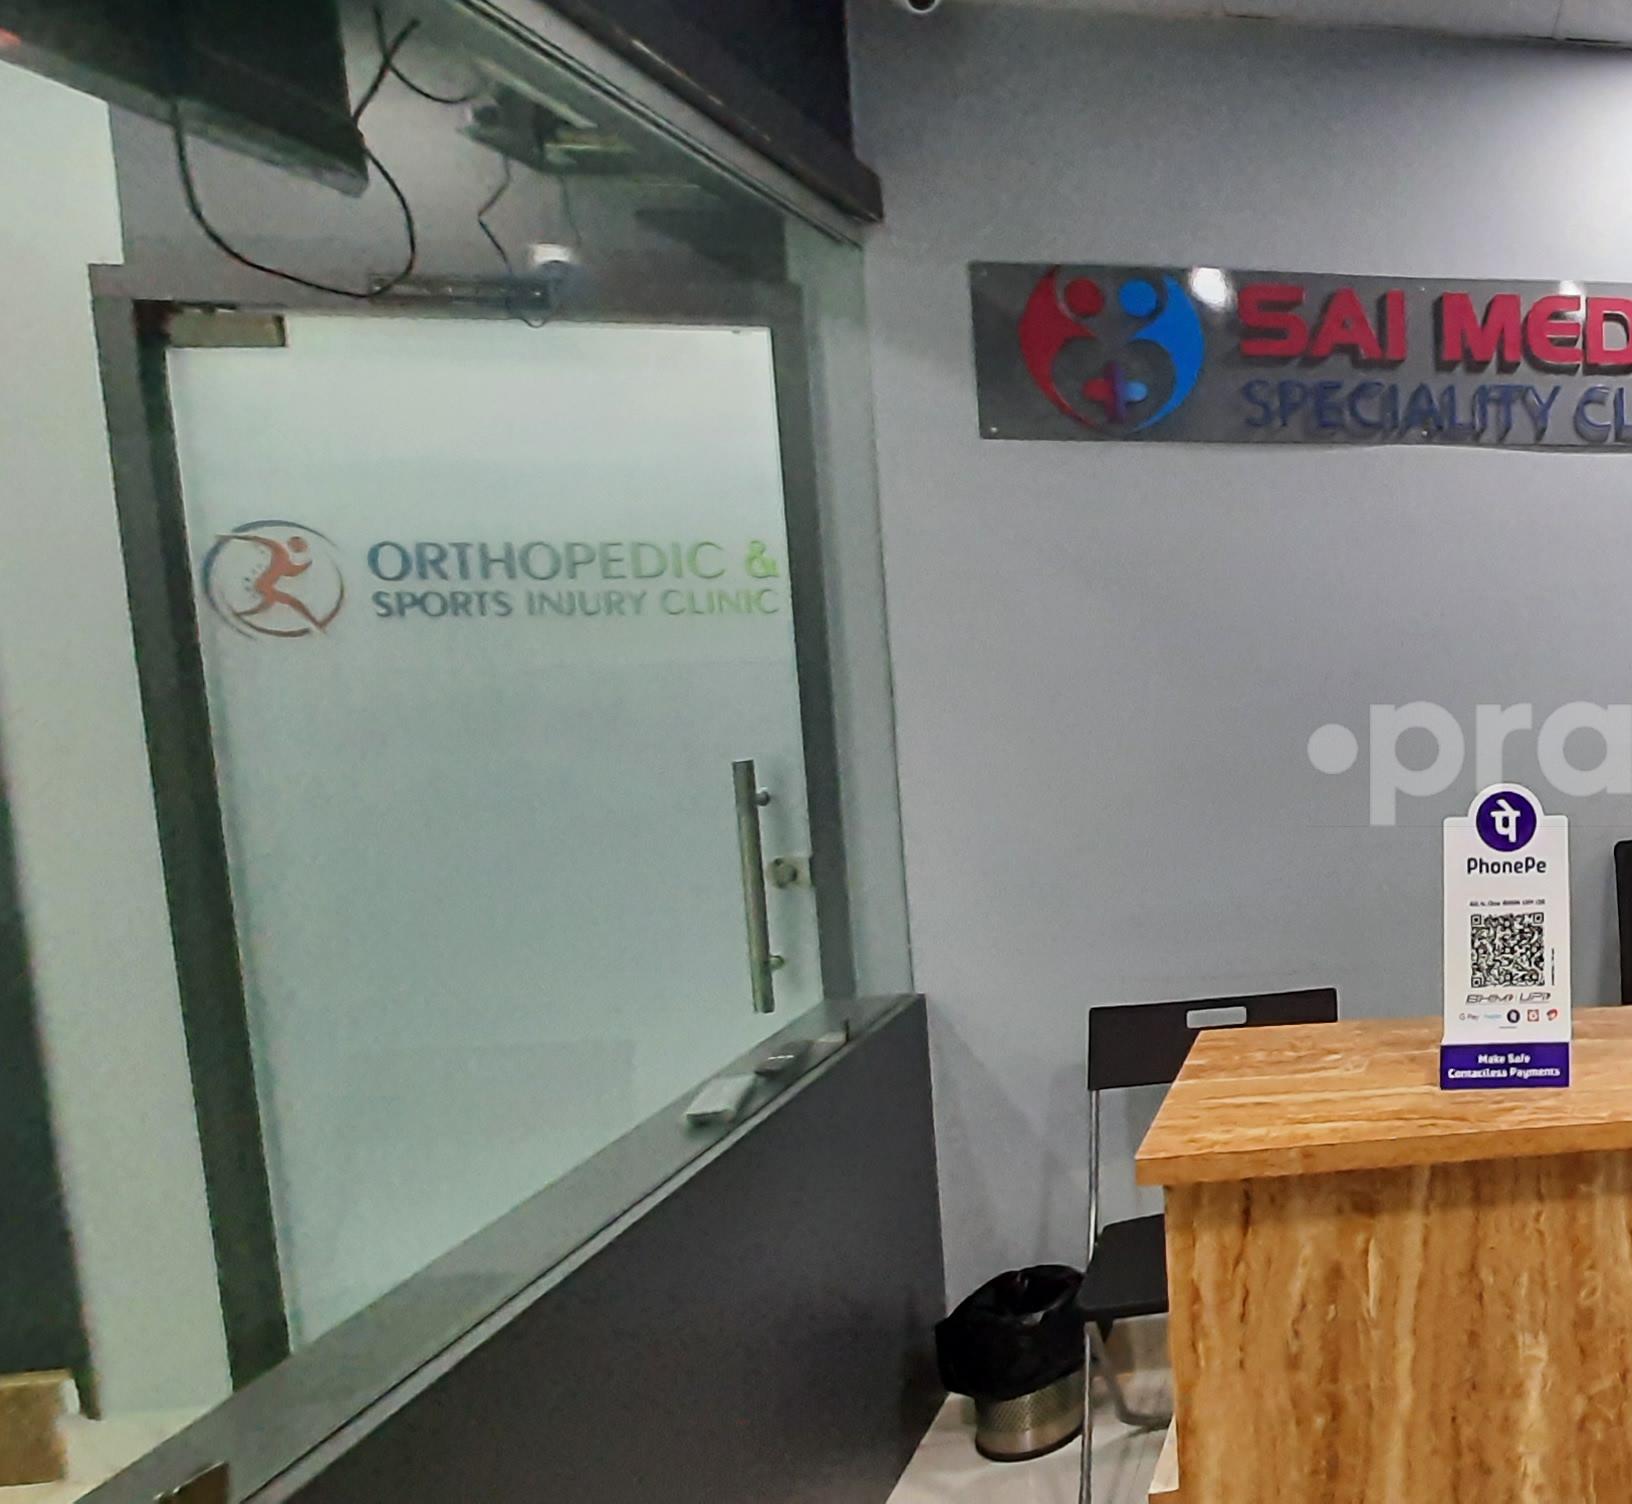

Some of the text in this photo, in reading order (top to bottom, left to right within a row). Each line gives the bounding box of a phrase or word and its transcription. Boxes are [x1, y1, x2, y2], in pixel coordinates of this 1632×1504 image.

[1238, 283, 1407, 367] SAI
[1241, 380, 1561, 442] SPECIALITY
[367, 540, 780, 582] ORTHOPEDIC &
[373, 587, 780, 618] SPORTS INJURY CLINIC
[1490, 798, 1520, 843] पे
[1466, 856, 1547, 875] PhonePe
[1447, 1066, 1561, 1080] Contactless Payments
[1477, 1053, 1531, 1065] Make Safe
